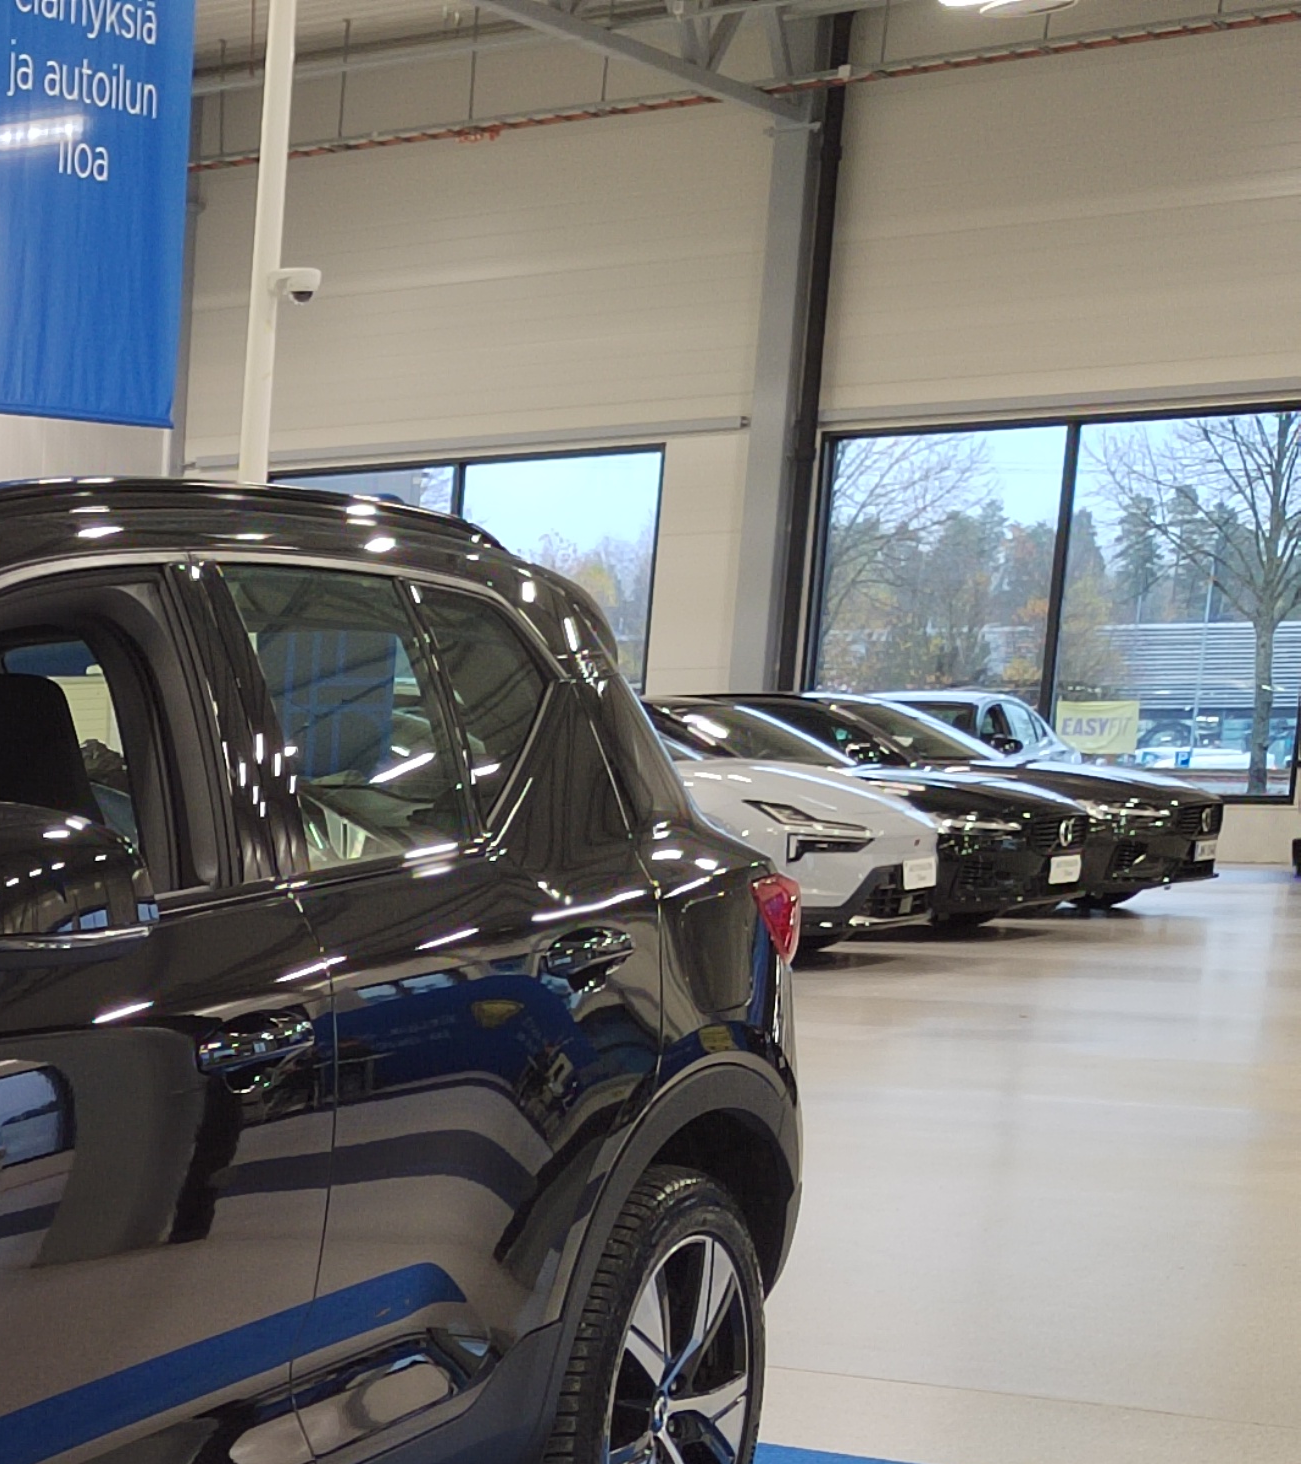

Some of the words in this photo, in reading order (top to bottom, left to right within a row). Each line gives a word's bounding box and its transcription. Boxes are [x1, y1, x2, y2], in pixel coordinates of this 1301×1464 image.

[15, 0, 158, 45] myksiä
[6, 38, 34, 97] ja
[43, 58, 158, 120] autoilun
